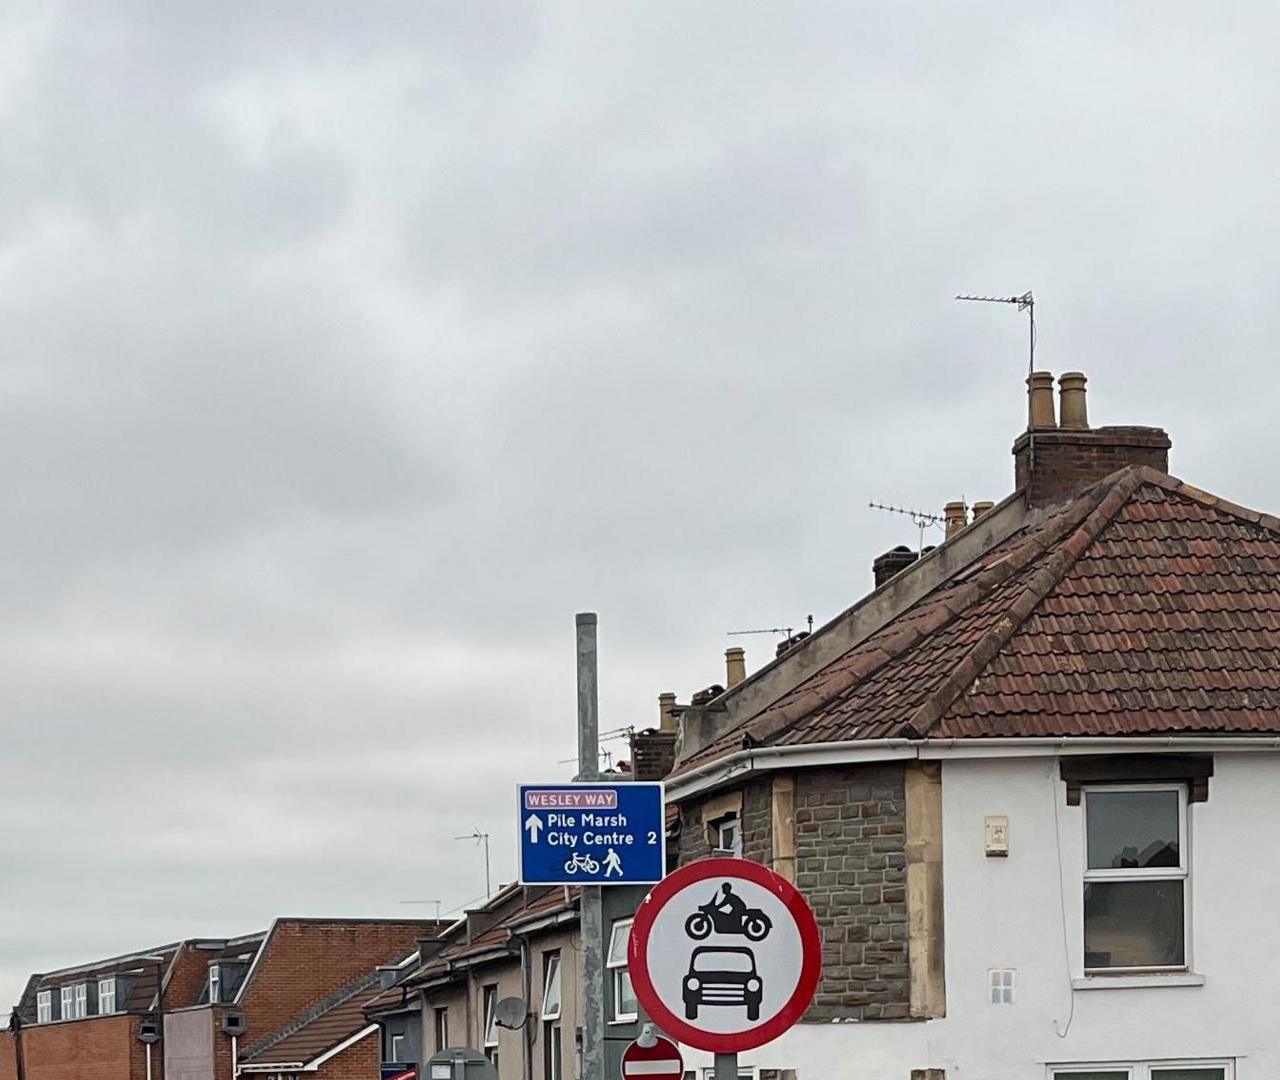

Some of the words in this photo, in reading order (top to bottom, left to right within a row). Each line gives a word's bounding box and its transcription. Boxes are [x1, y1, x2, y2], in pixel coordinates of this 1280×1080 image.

[528, 794, 581, 806] WESLEY
[585, 794, 614, 806] WAY
[547, 814, 576, 827] Pile
[581, 813, 627, 827] Marsh
[547, 831, 578, 848] City
[583, 831, 634, 845] Centre
[647, 831, 657, 845] 2
